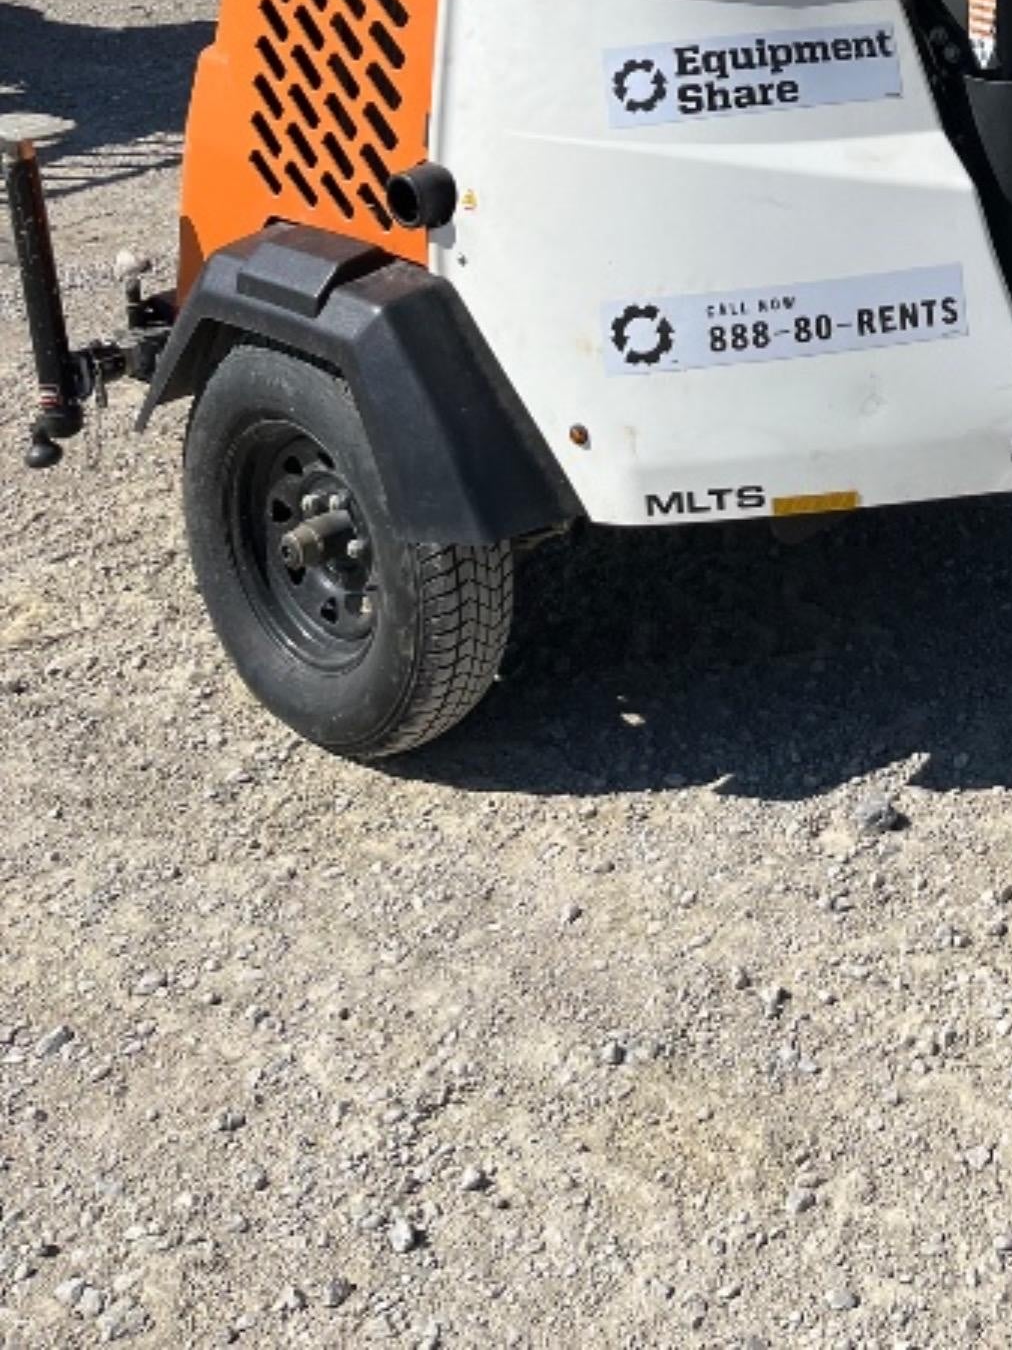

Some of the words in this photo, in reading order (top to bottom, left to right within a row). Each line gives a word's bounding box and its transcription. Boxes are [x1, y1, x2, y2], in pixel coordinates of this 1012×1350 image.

[673, 29, 893, 80] Equipment
[676, 78, 800, 115] Share
[709, 296, 959, 352] 888-80-RENTS
[644, 485, 767, 517] MLTS
